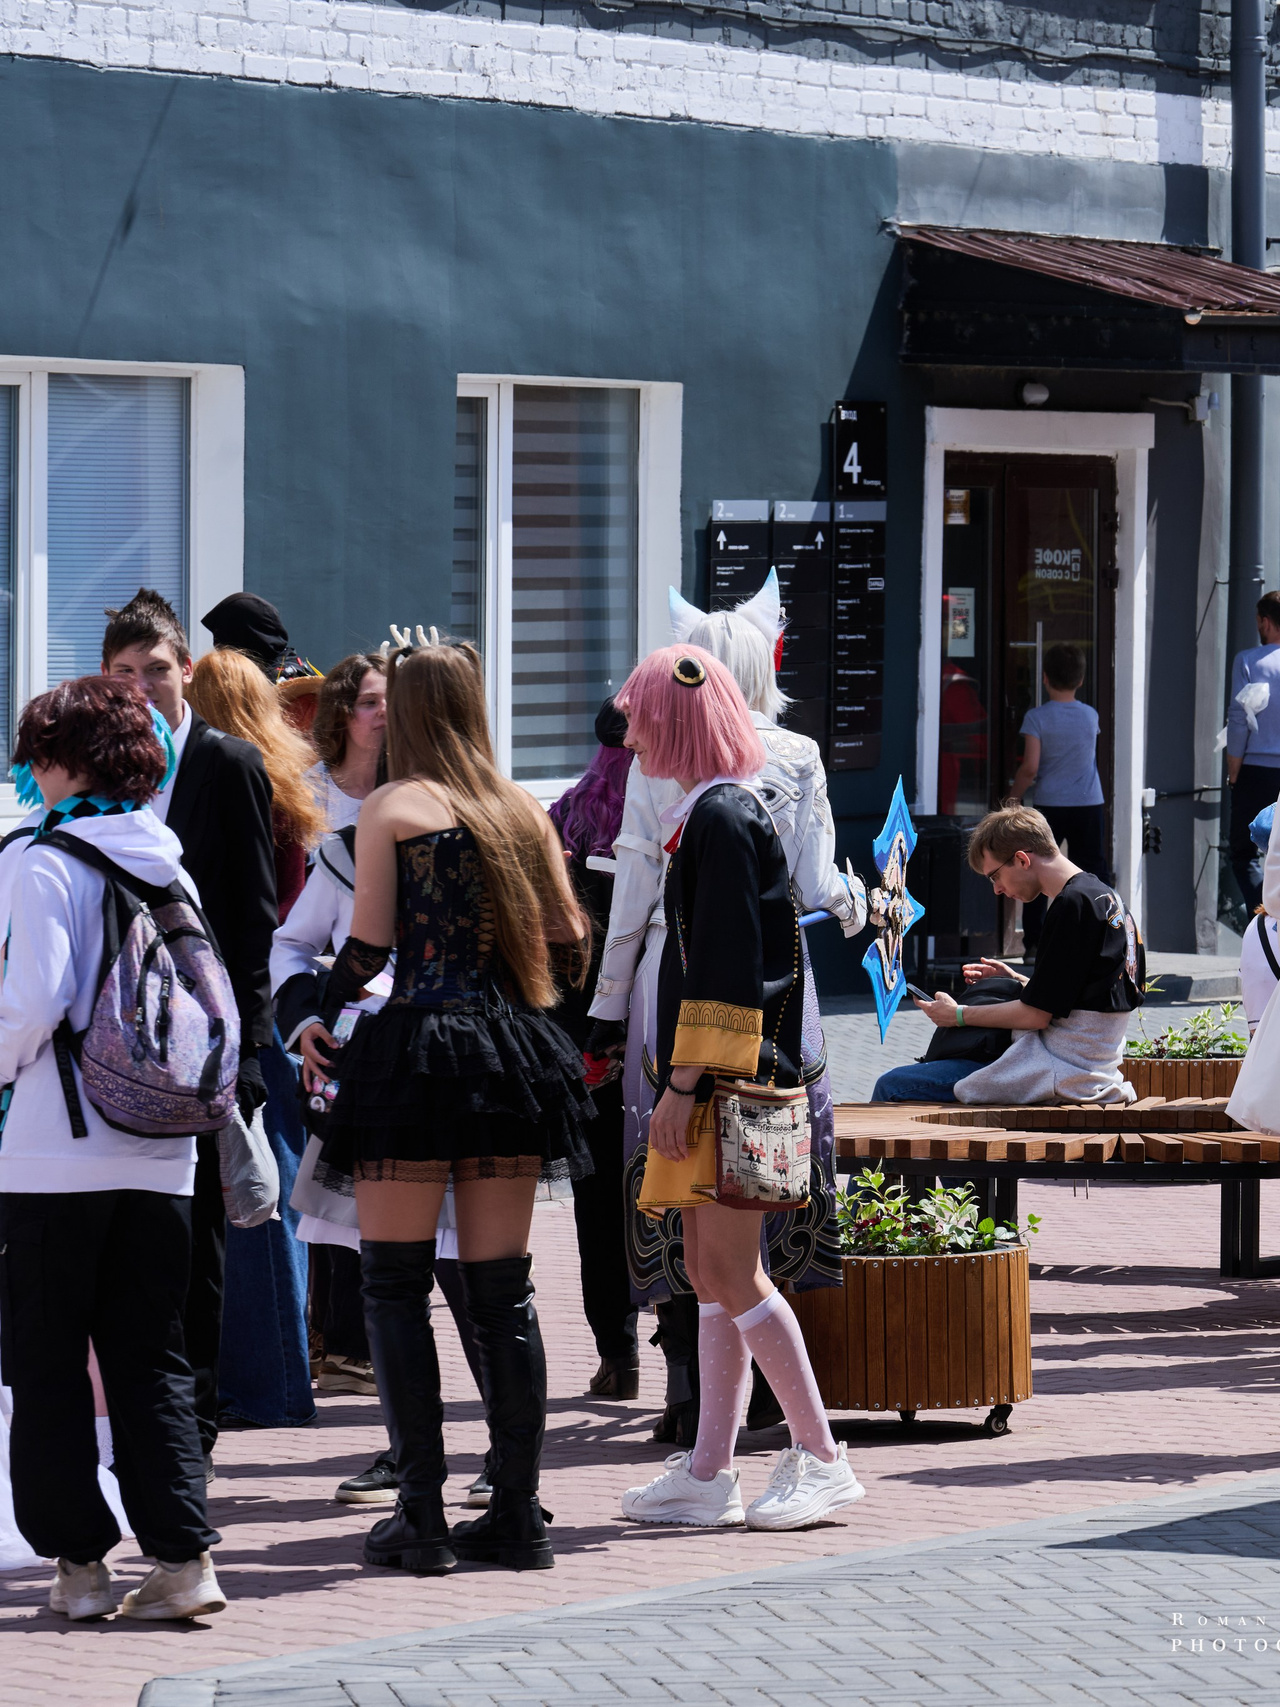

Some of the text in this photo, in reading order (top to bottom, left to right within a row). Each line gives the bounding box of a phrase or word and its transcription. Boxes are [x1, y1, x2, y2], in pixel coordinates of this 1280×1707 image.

[843, 442, 862, 485] 4
[717, 503, 724, 518] 2
[779, 504, 786, 518] 2
[838, 504, 845, 518] 1
